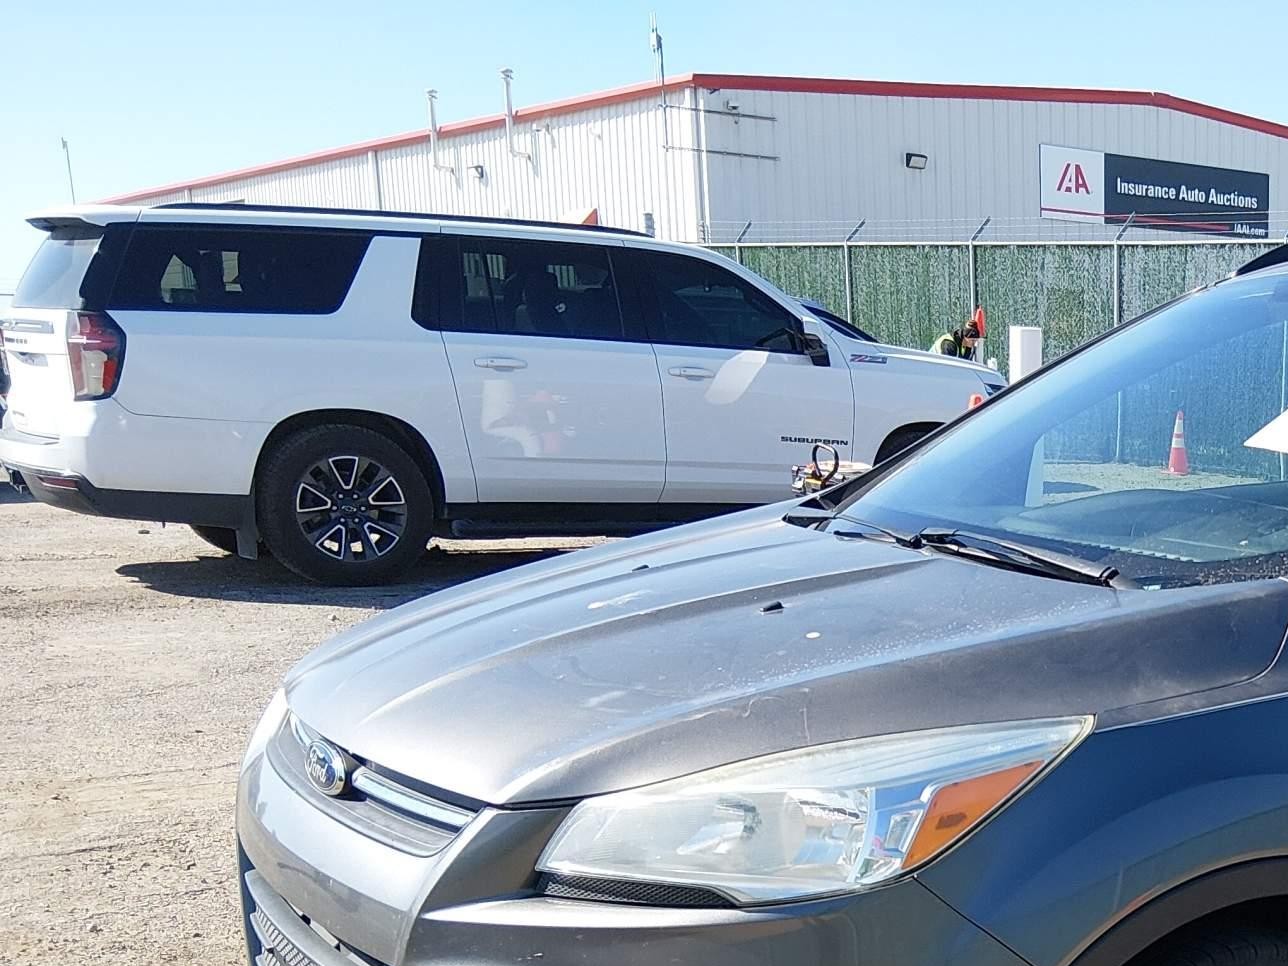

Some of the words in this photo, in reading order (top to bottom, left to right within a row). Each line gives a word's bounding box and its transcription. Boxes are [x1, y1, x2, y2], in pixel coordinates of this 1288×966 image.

[1117, 177, 1176, 200] Insurance
[1179, 185, 1205, 204] Auto
[1208, 189, 1258, 210] Auctions
[780, 436, 849, 446] SUBURBAN
[308, 744, 329, 784] Ford
